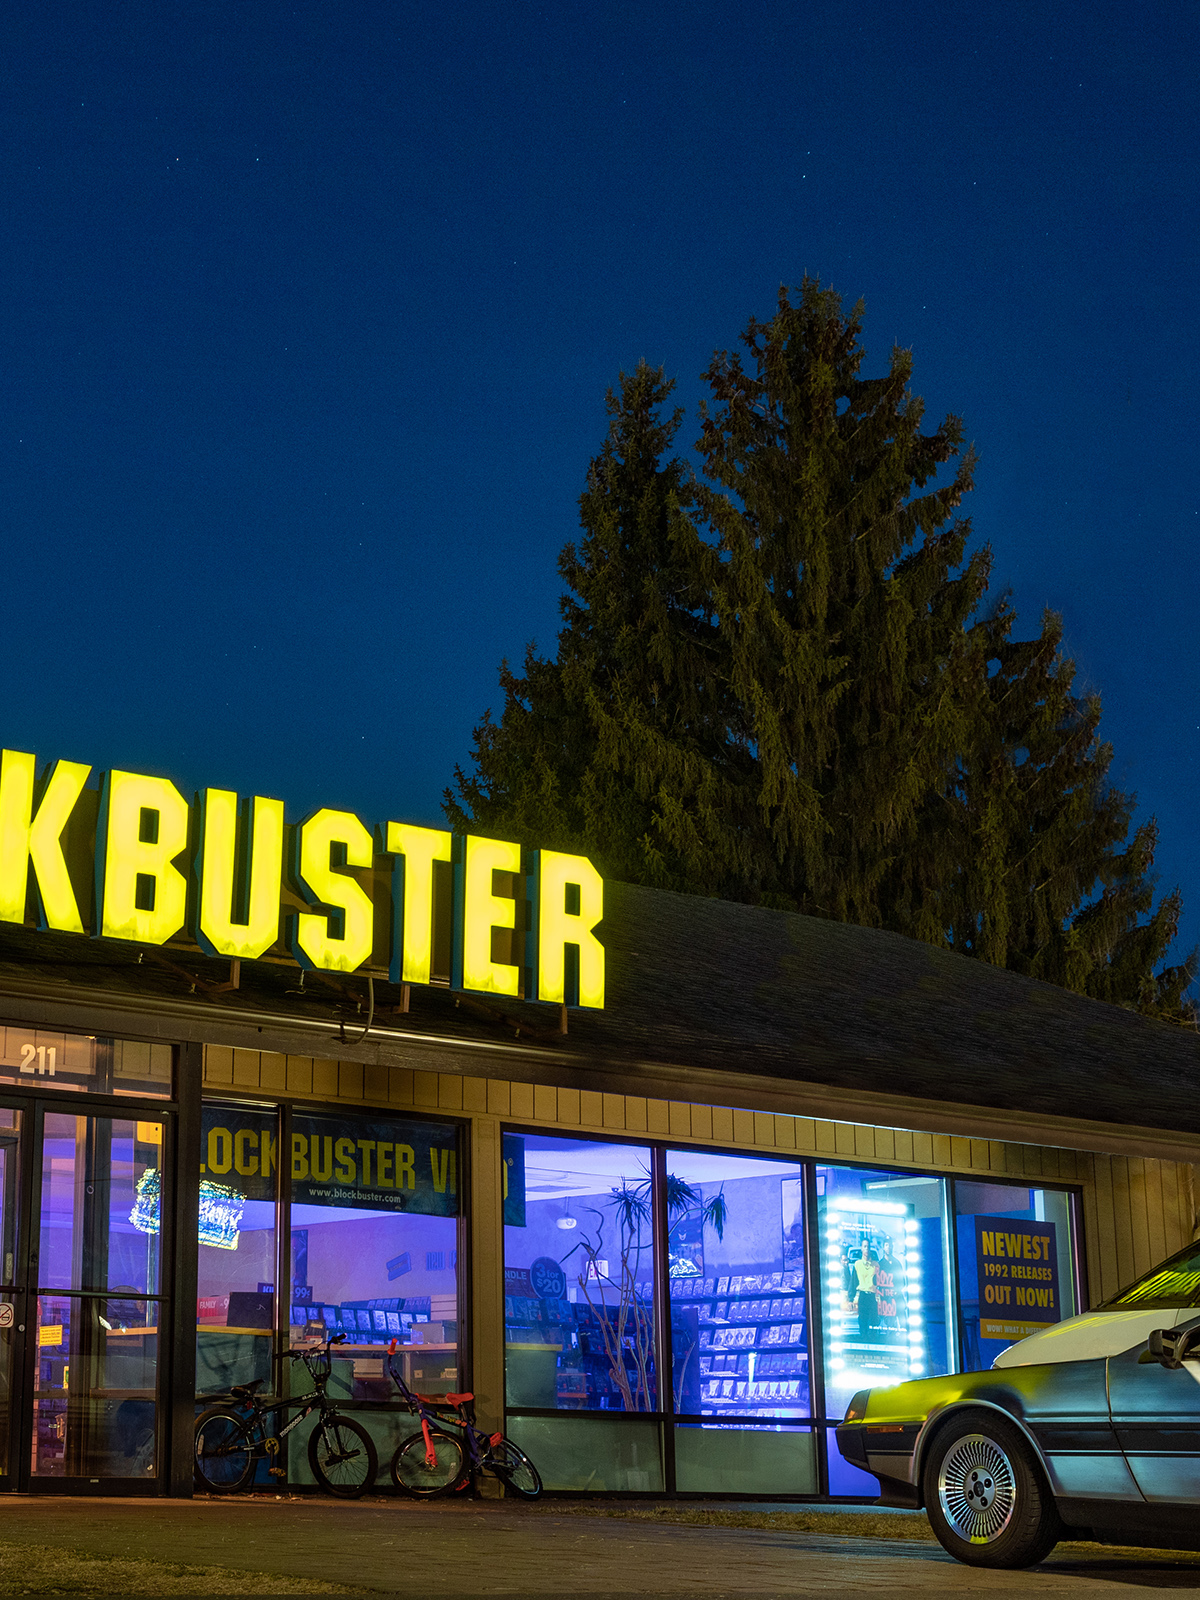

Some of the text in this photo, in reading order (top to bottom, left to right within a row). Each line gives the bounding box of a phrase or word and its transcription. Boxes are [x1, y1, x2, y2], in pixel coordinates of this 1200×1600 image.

[20, 1044, 57, 1076] 211
[309, 1187, 401, 1204] www.blockbuster.com
[981, 1231, 1050, 1261] NEWEST
[535, 1263, 560, 1279] 3 for
[984, 1262, 1053, 1281] 1992 RELEASES
[536, 1279, 560, 1294] $20
[984, 1284, 1055, 1308] OUT NOW!
